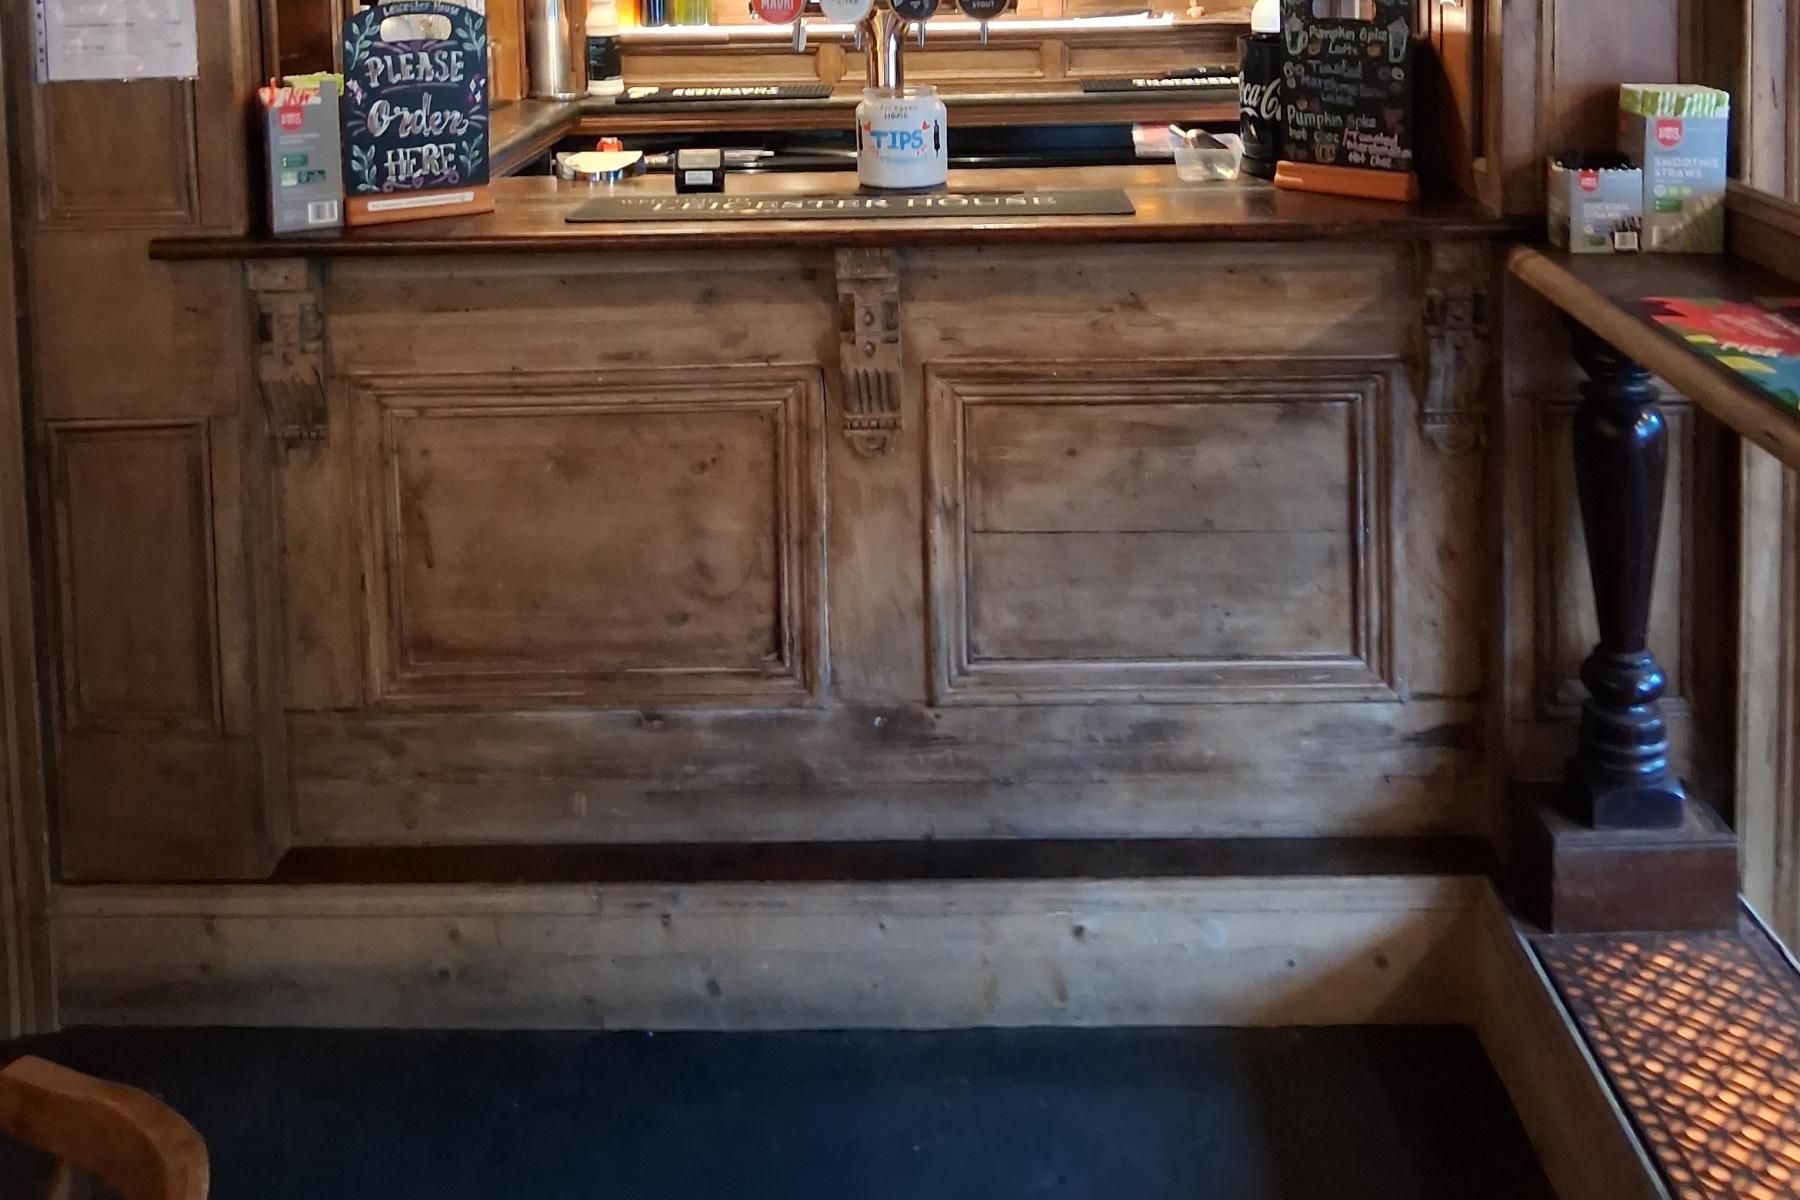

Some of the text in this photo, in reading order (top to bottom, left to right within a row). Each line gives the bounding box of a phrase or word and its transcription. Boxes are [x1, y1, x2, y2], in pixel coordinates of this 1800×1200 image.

[971, 0, 995, 10] STOUT
[364, 50, 464, 88] PLEASE
[367, 91, 471, 138] Order
[1287, 103, 1343, 129] Pumpkin
[870, 129, 923, 151] TIPS
[384, 142, 457, 182] HERE
